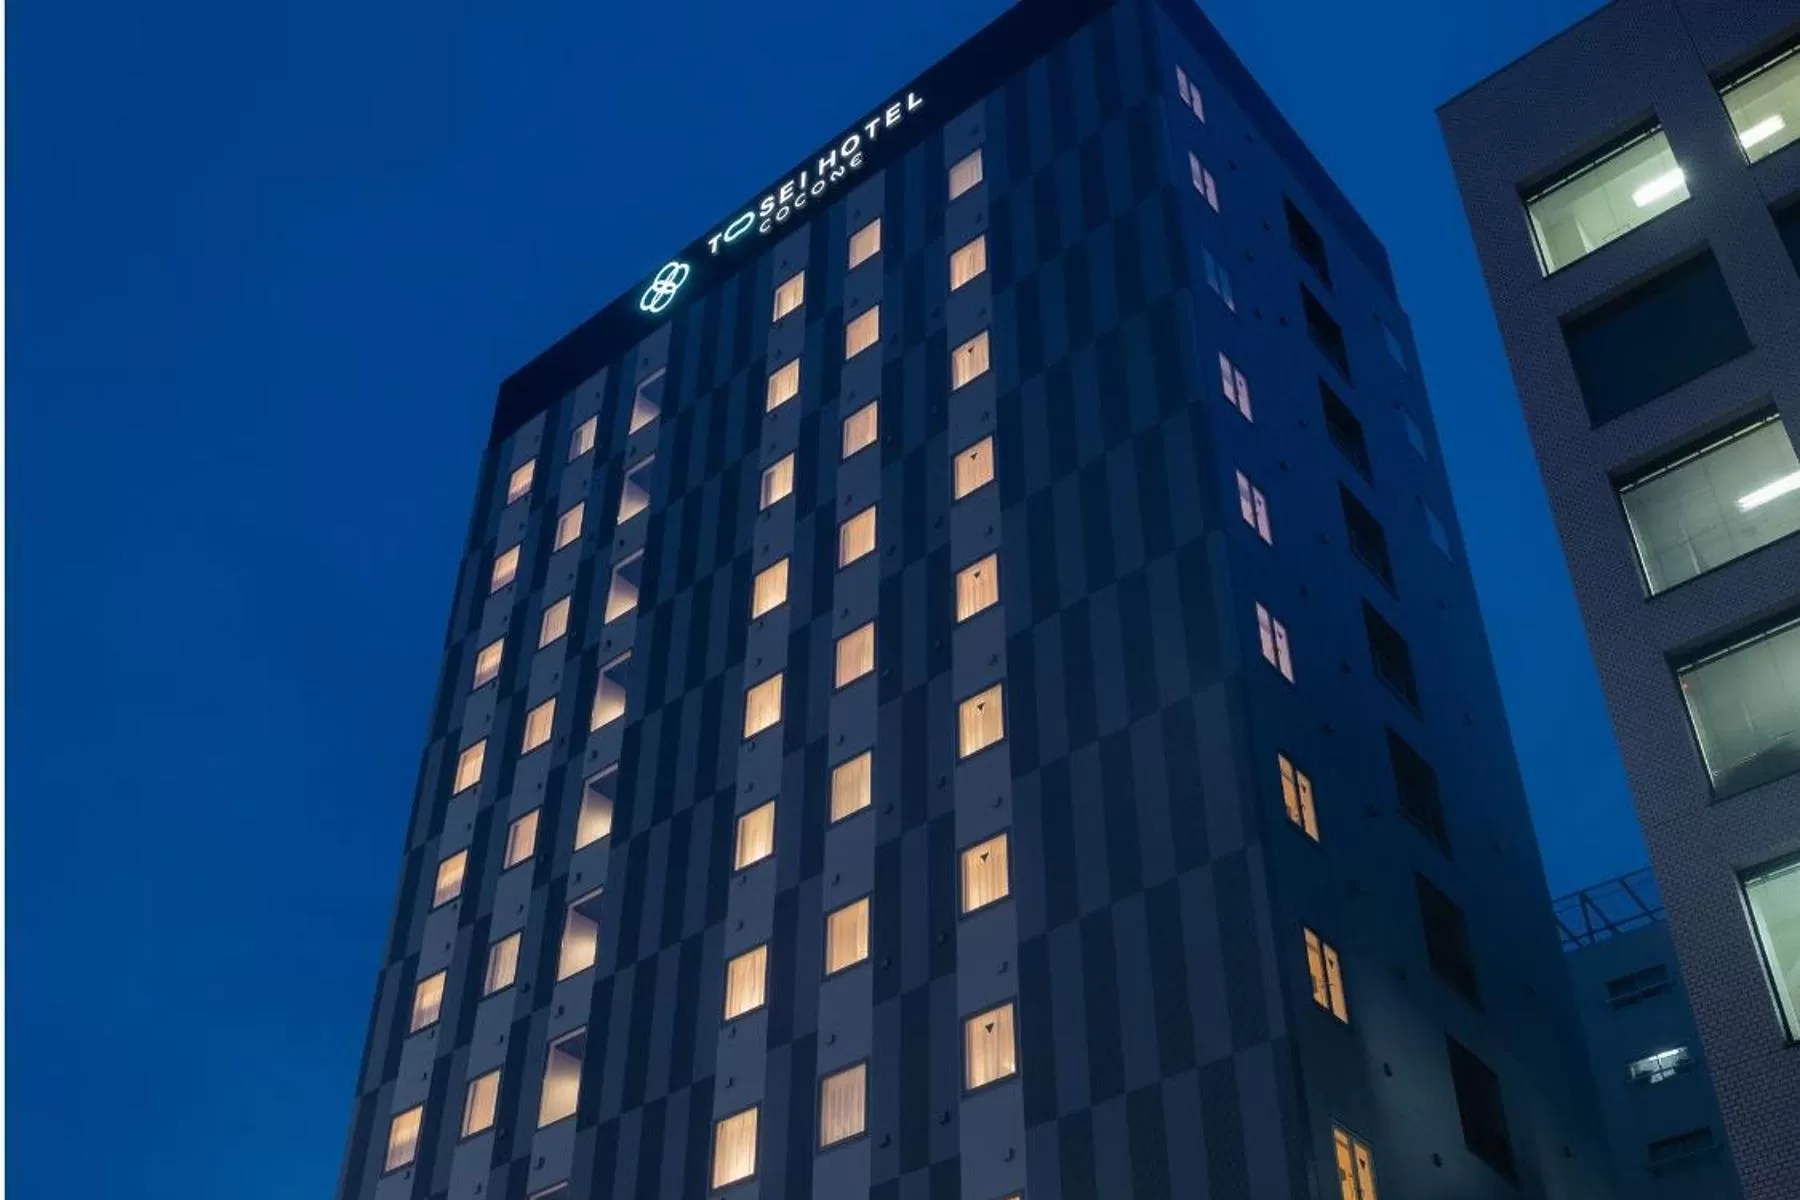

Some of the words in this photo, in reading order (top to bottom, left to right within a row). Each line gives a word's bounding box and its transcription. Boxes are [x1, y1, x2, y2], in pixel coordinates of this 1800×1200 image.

[708, 171, 807, 254] TOSEI
[819, 91, 923, 176] HOTEL
[759, 151, 864, 233] COCONE
